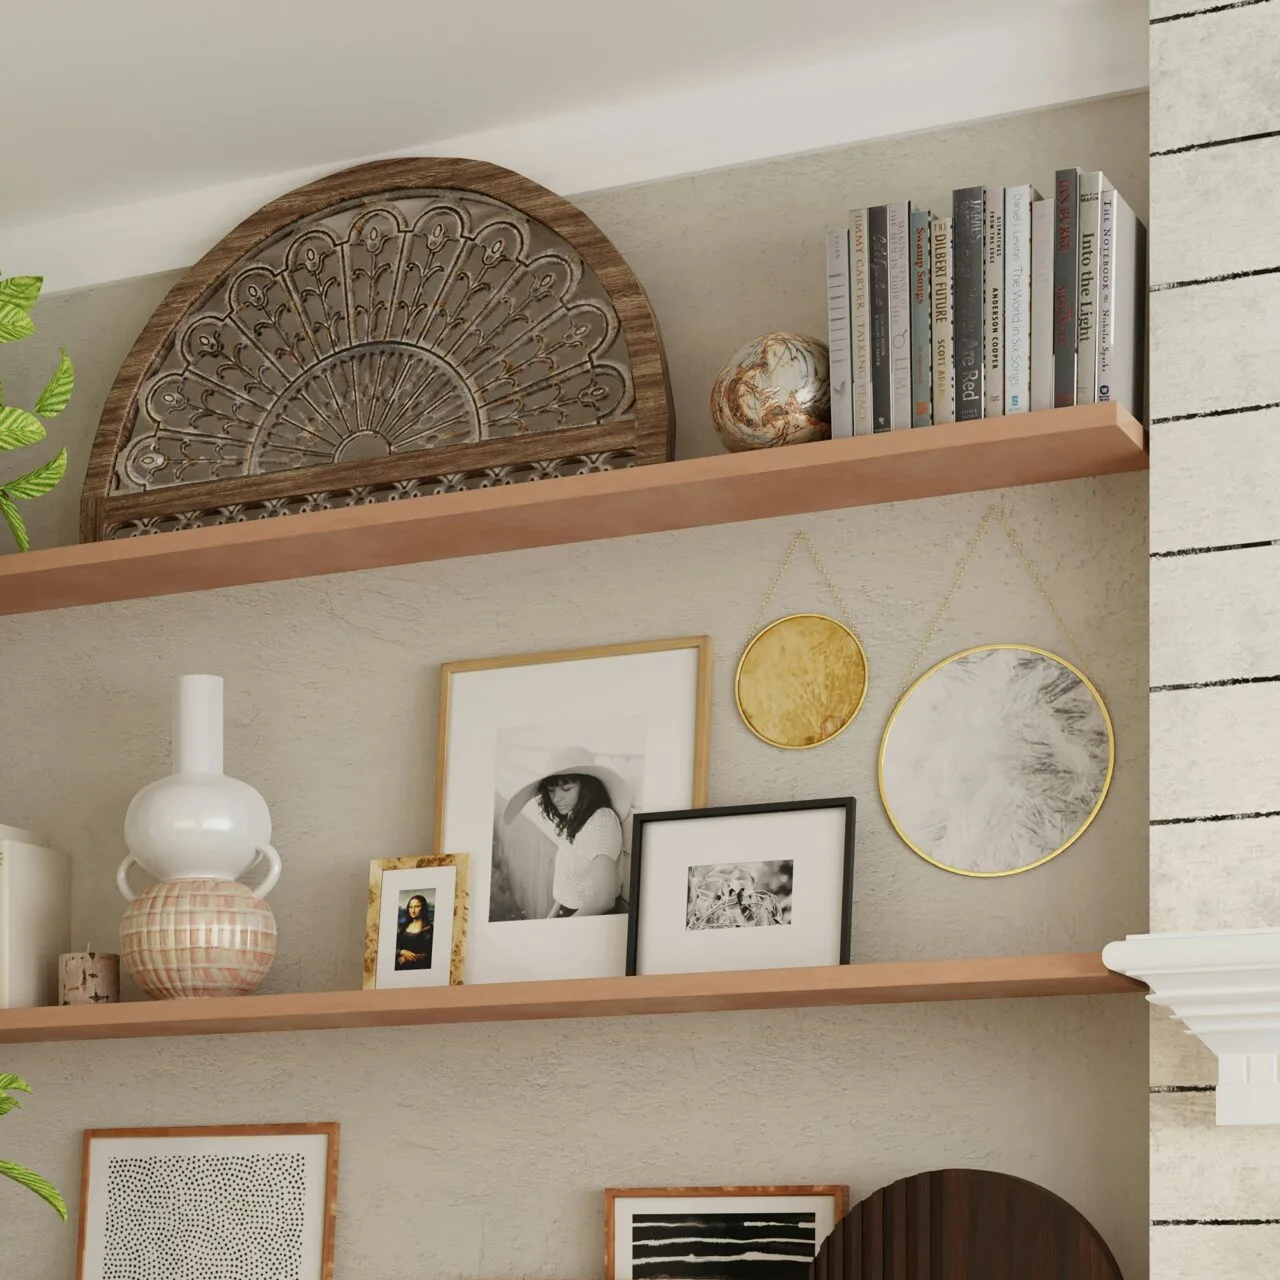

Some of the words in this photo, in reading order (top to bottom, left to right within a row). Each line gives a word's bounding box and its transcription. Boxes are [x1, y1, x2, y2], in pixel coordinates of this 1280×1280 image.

[1103, 200, 1112, 223] THE
[854, 214, 864, 253] JIMMY
[915, 227, 926, 268] Swamp
[1081, 232, 1095, 267] Into
[934, 234, 947, 278] DILBERT
[1102, 228, 1112, 290] NOTEBOOK
[856, 259, 865, 310] CARTER
[915, 271, 926, 304] Songs
[1011, 265, 1024, 287] The
[1080, 270, 1094, 297] the
[935, 282, 948, 324] FUTURE
[991, 287, 999, 333] ANDERSON
[1011, 288, 1023, 324] World
[1078, 300, 1093, 343] Light
[1101, 309, 1110, 343] Nicholas
[856, 321, 867, 378] TALKING
[937, 339, 946, 367] SCOTT
[961, 338, 979, 366] Are
[991, 336, 999, 369] COOPER
[1010, 337, 1022, 353] Six
[962, 370, 980, 401] Red
[1008, 355, 1022, 387] Songs
